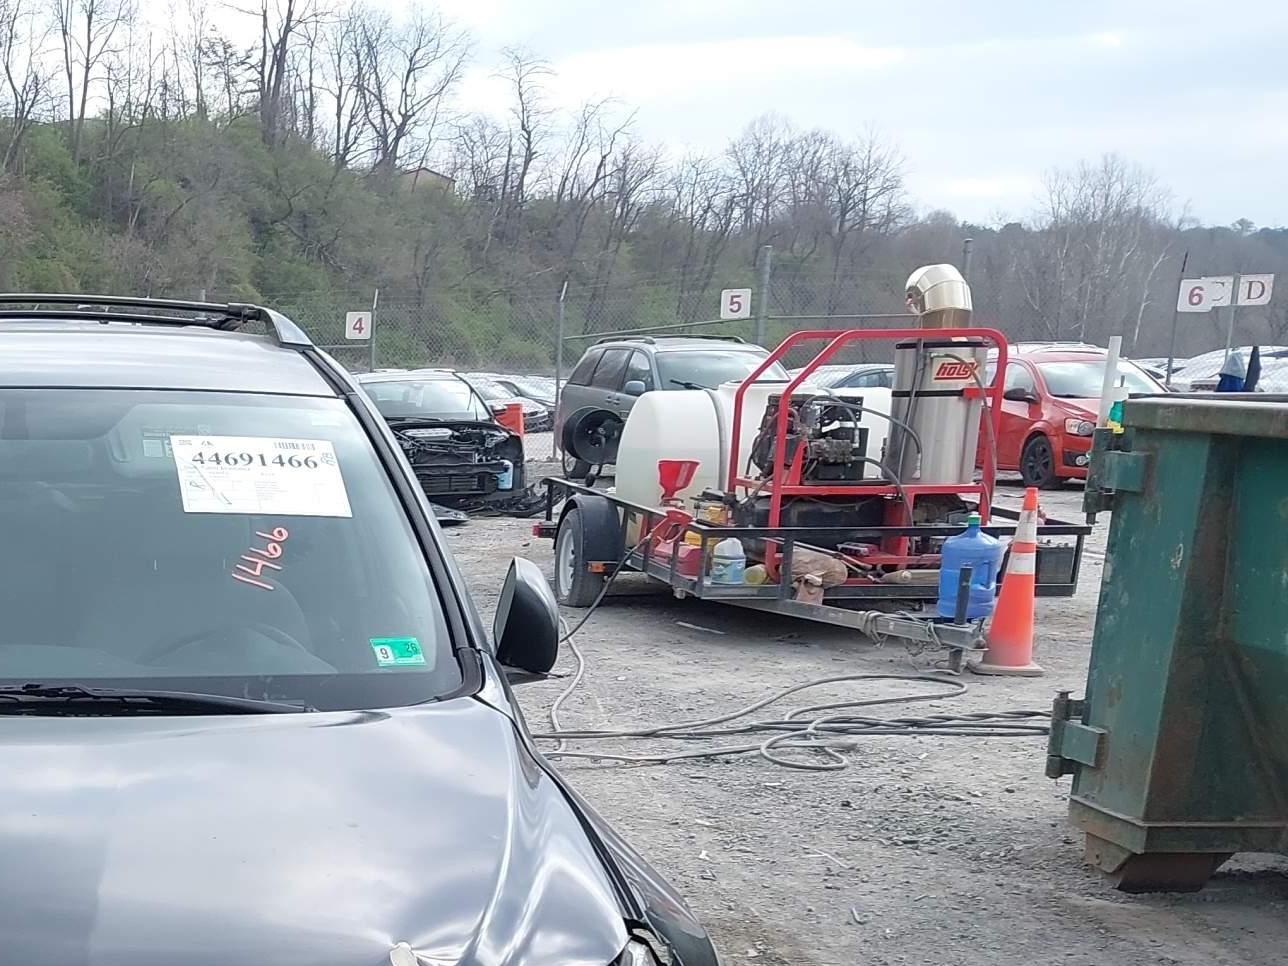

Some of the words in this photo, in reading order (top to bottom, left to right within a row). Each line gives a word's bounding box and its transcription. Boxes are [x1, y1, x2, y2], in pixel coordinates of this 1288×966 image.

[1188, 285, 1204, 306] 6
[1246, 280, 1265, 300] D
[729, 294, 742, 313] 5
[352, 317, 364, 334] 4
[191, 451, 318, 469] 44691466
[231, 527, 289, 590] 1466
[379, 647, 389, 659] 9
